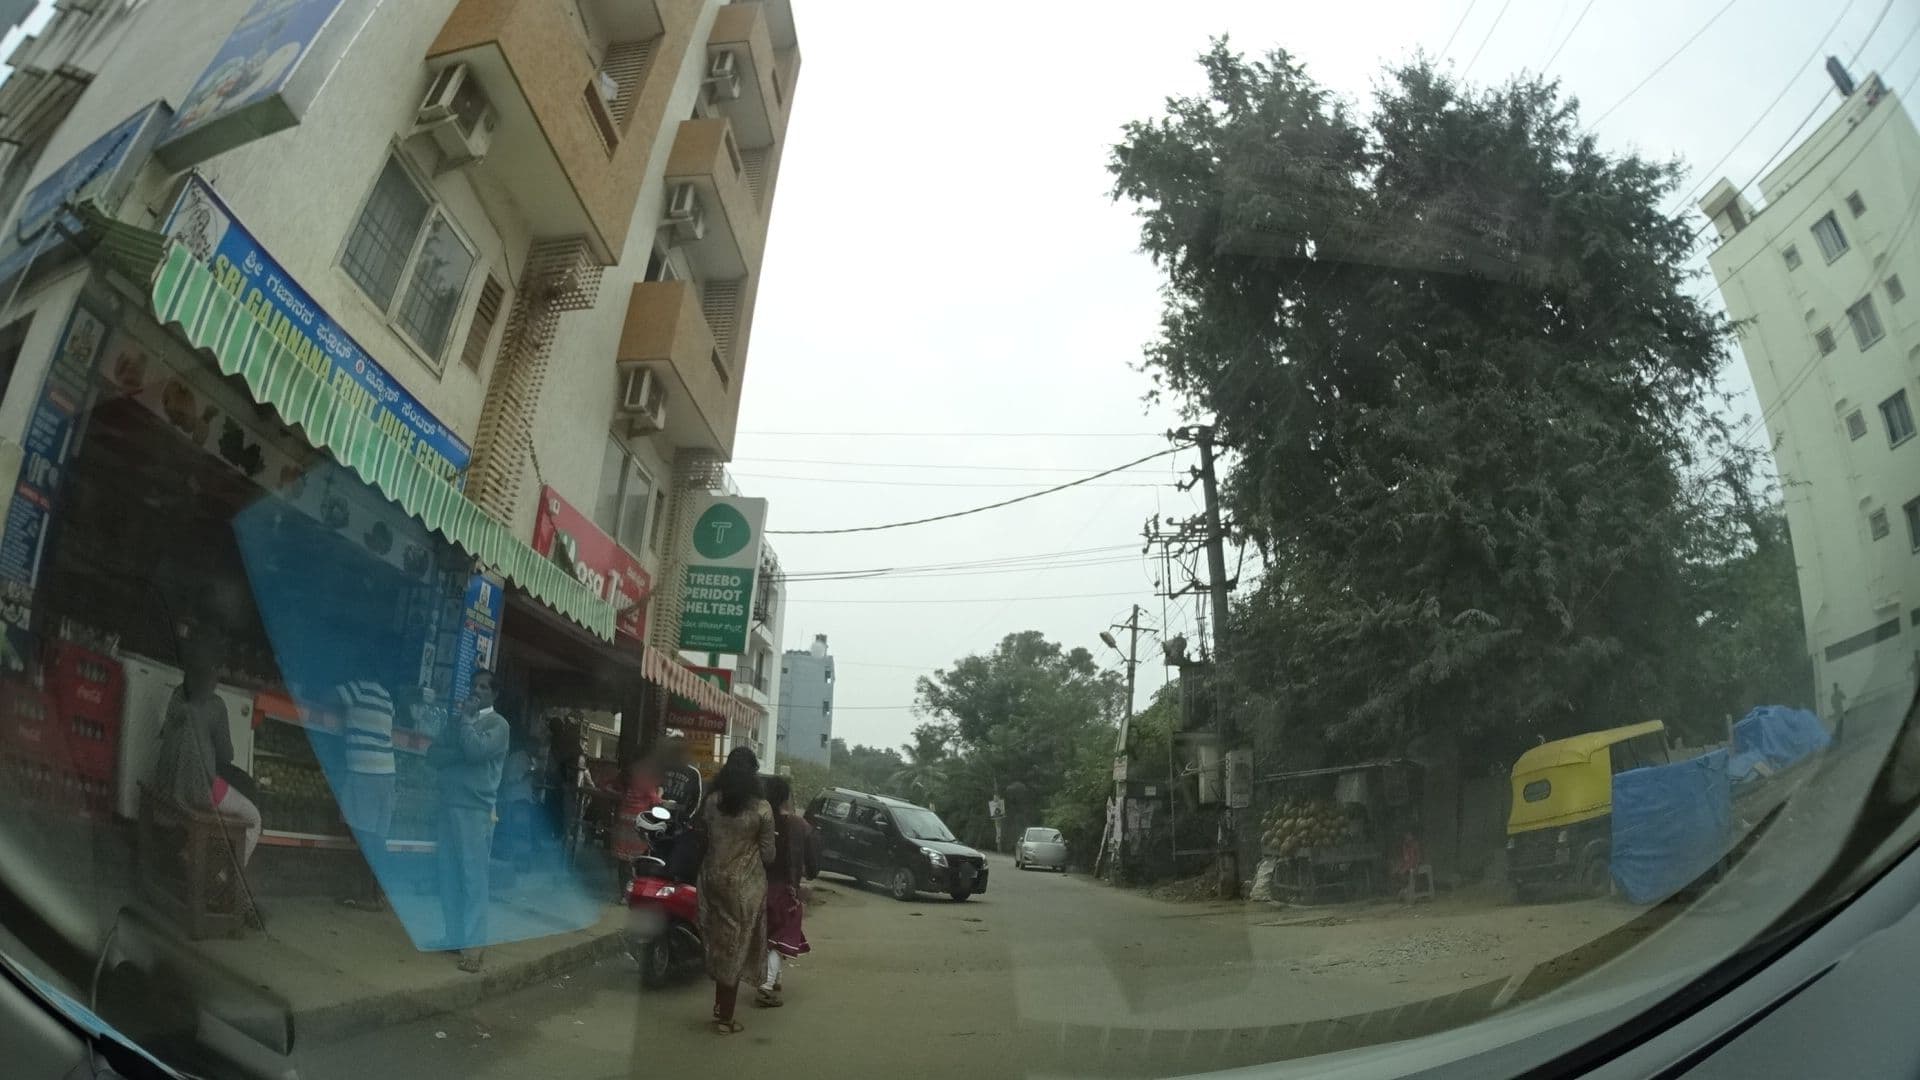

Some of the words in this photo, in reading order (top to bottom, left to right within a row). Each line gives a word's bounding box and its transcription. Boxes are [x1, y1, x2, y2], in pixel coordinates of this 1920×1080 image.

[213, 254, 248, 299] SRI
[246, 287, 333, 382] GAJANANA
[332, 366, 379, 414] FRUIT
[377, 406, 417, 449] JUICE
[689, 573, 741, 588] TREEBO
[686, 586, 743, 602] PERIDOT
